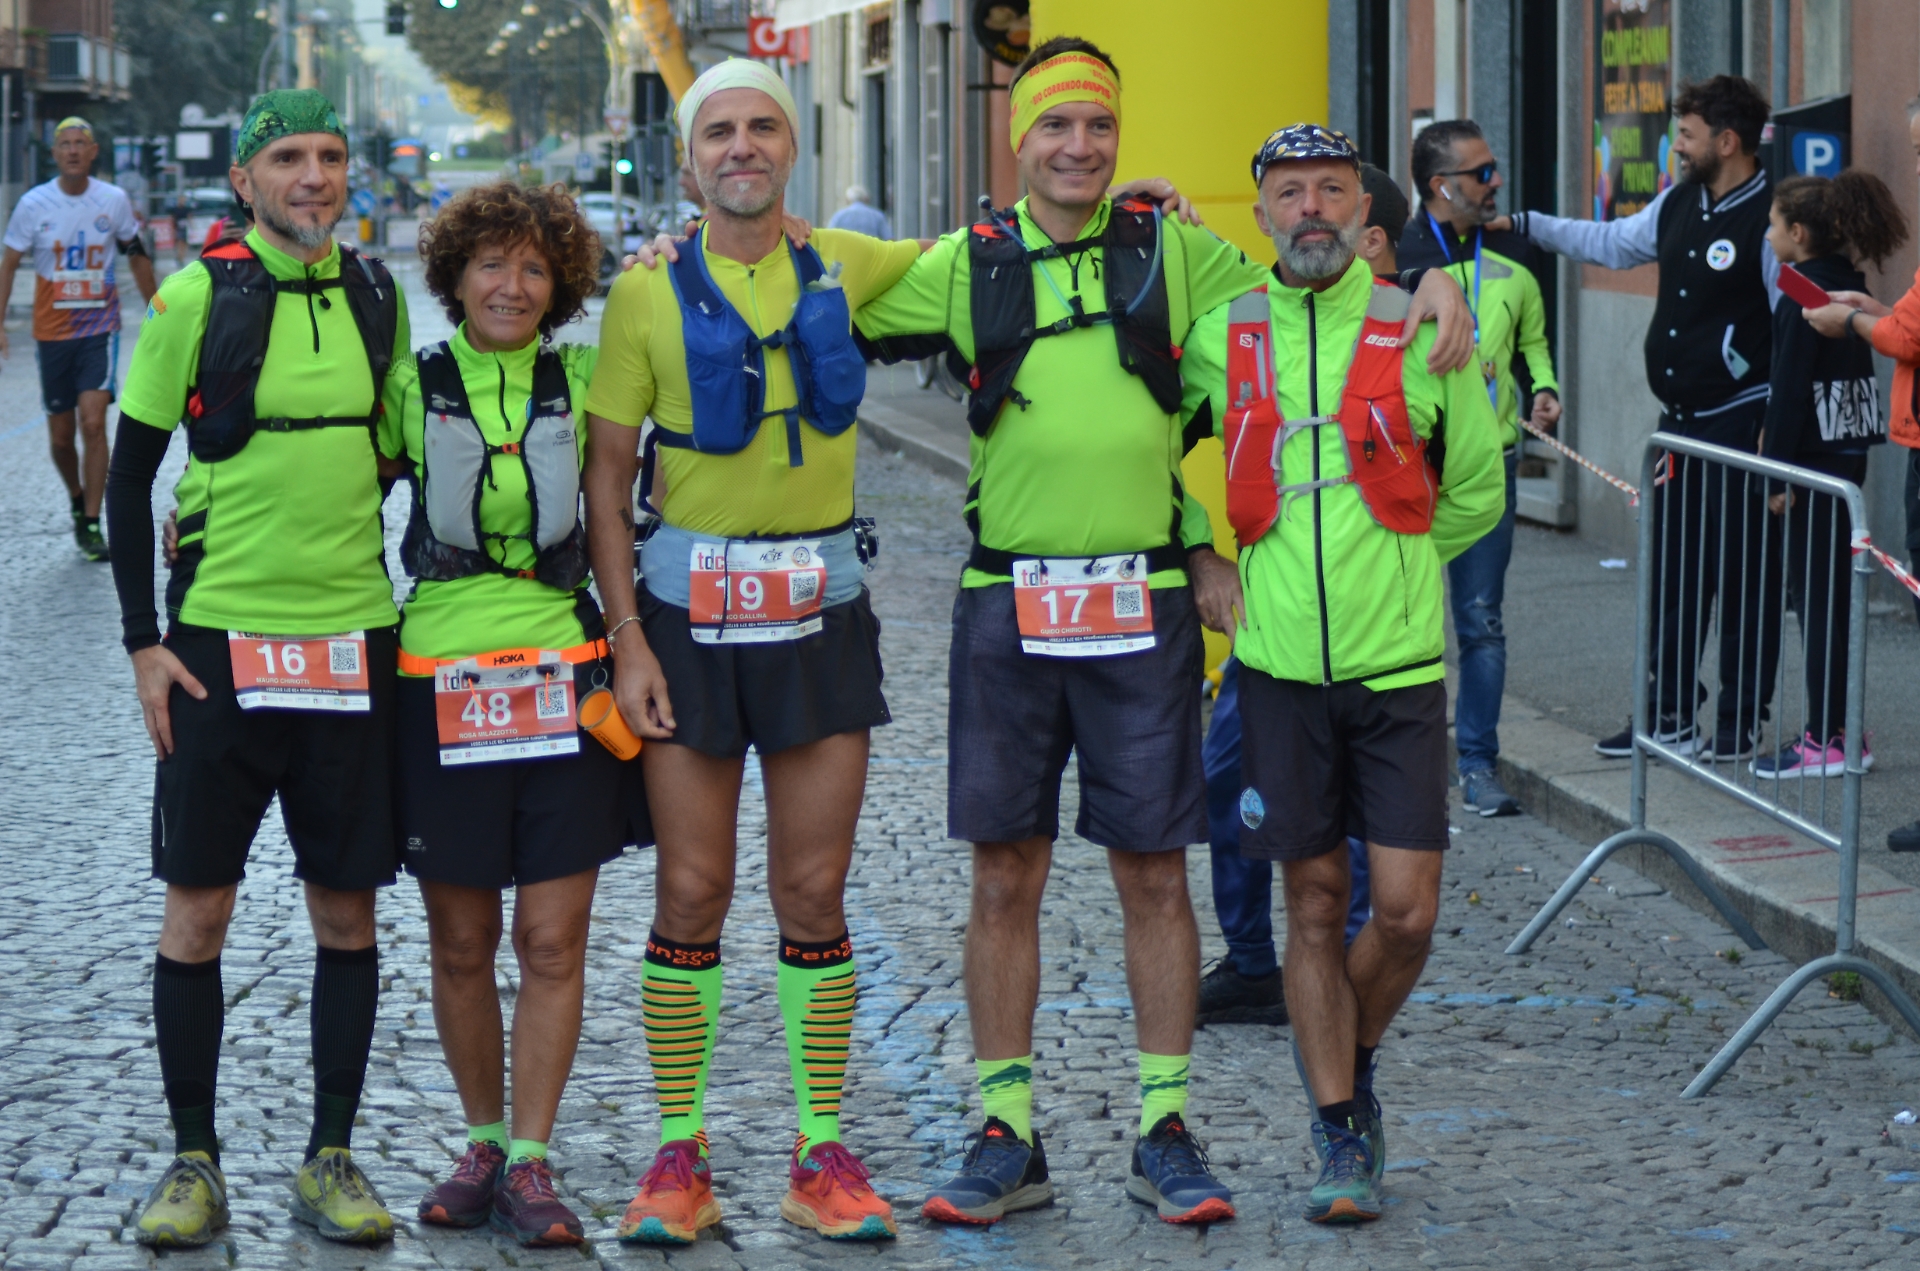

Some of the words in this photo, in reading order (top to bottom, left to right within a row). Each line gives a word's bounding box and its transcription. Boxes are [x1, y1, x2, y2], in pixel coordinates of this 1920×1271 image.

[1043, 80, 1081, 98] CORRENDO
[1805, 138, 1834, 177] P
[53, 230, 104, 271] tdc
[61, 282, 82, 296] 49
[1366, 335, 1398, 346] LAB
[697, 548, 725, 570] tdc
[1021, 565, 1049, 586] tdc
[715, 575, 764, 611] 19
[1040, 588, 1089, 625] 17
[256, 643, 306, 675] 16
[494, 653, 525, 666] HOKA
[461, 692, 512, 727] 48
[478, 728, 518, 738] MILAZZOTTO
